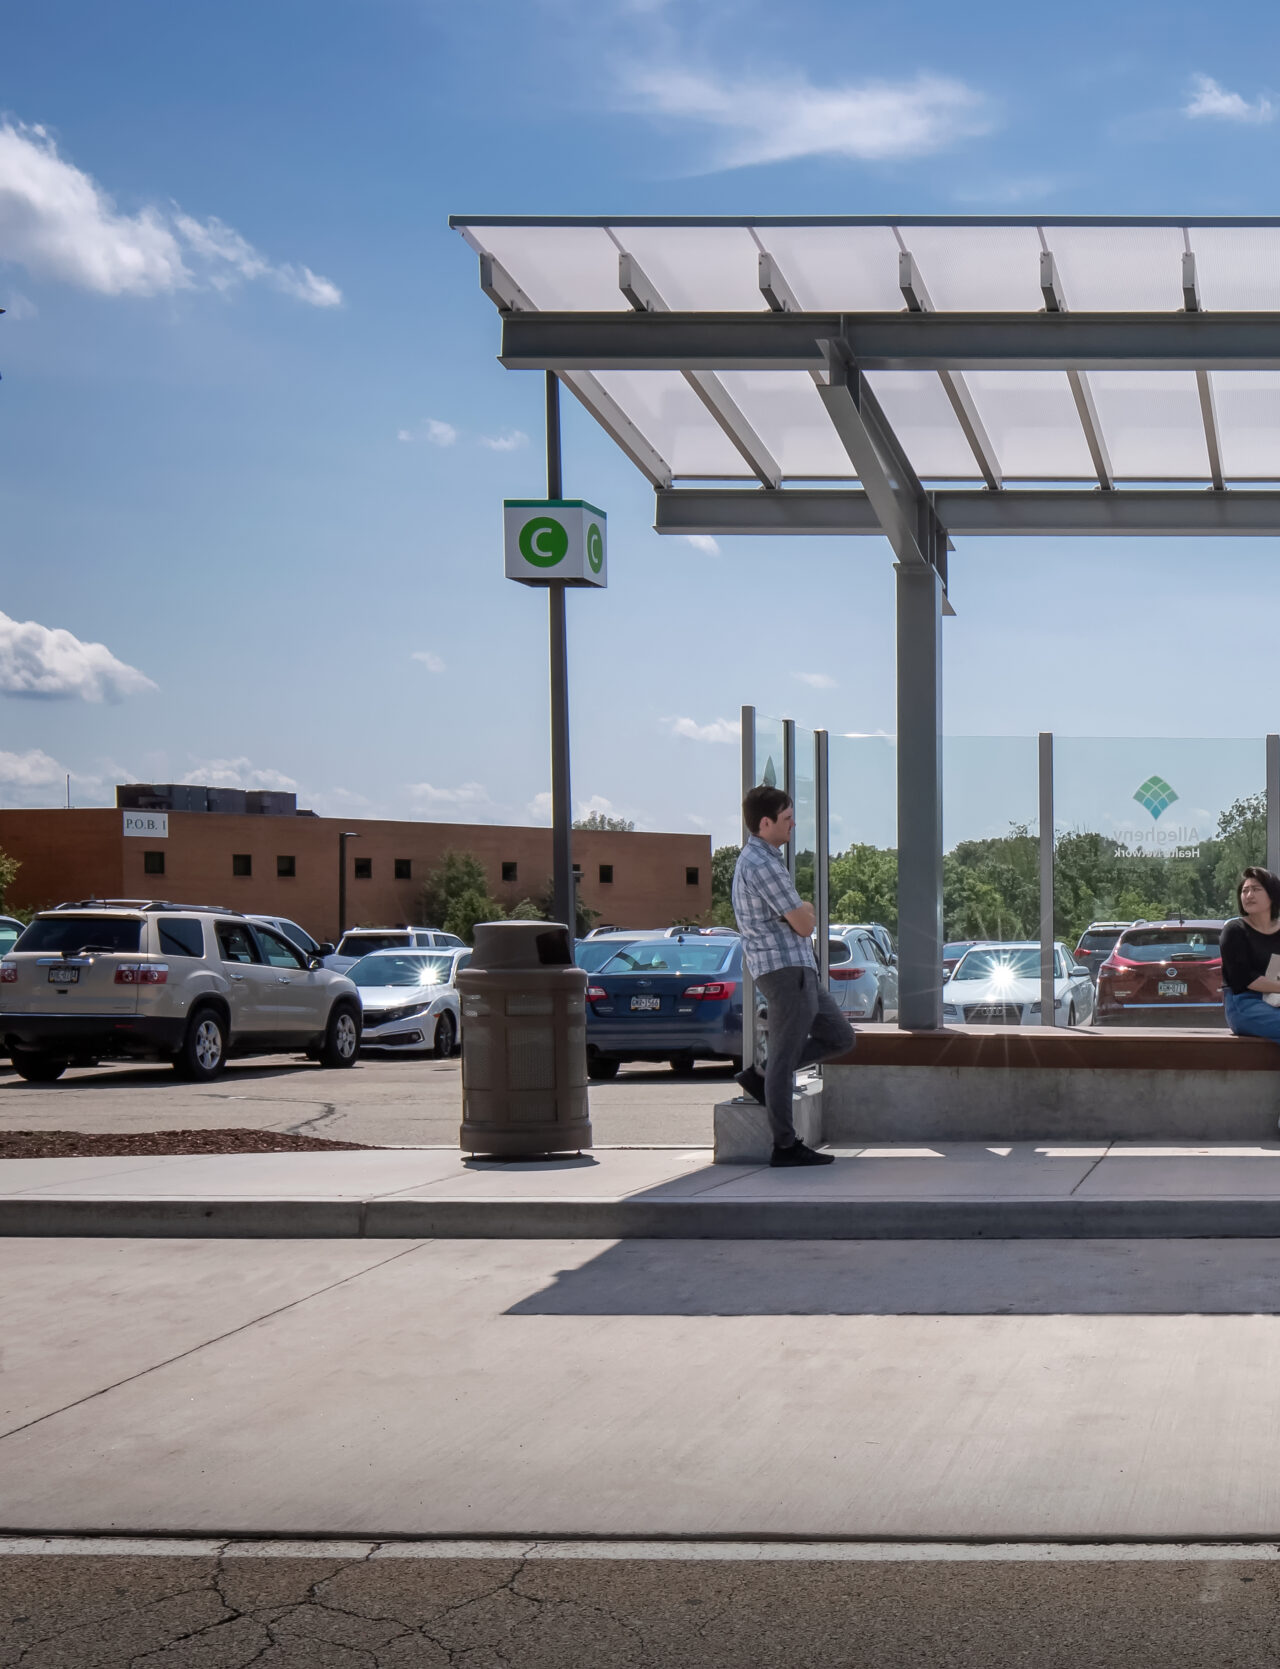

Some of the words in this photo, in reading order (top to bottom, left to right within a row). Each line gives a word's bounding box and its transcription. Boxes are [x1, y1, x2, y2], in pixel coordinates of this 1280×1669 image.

[531, 528, 553, 557] C
[590, 534, 599, 564] C
[126, 819, 158, 830] P.O.B.
